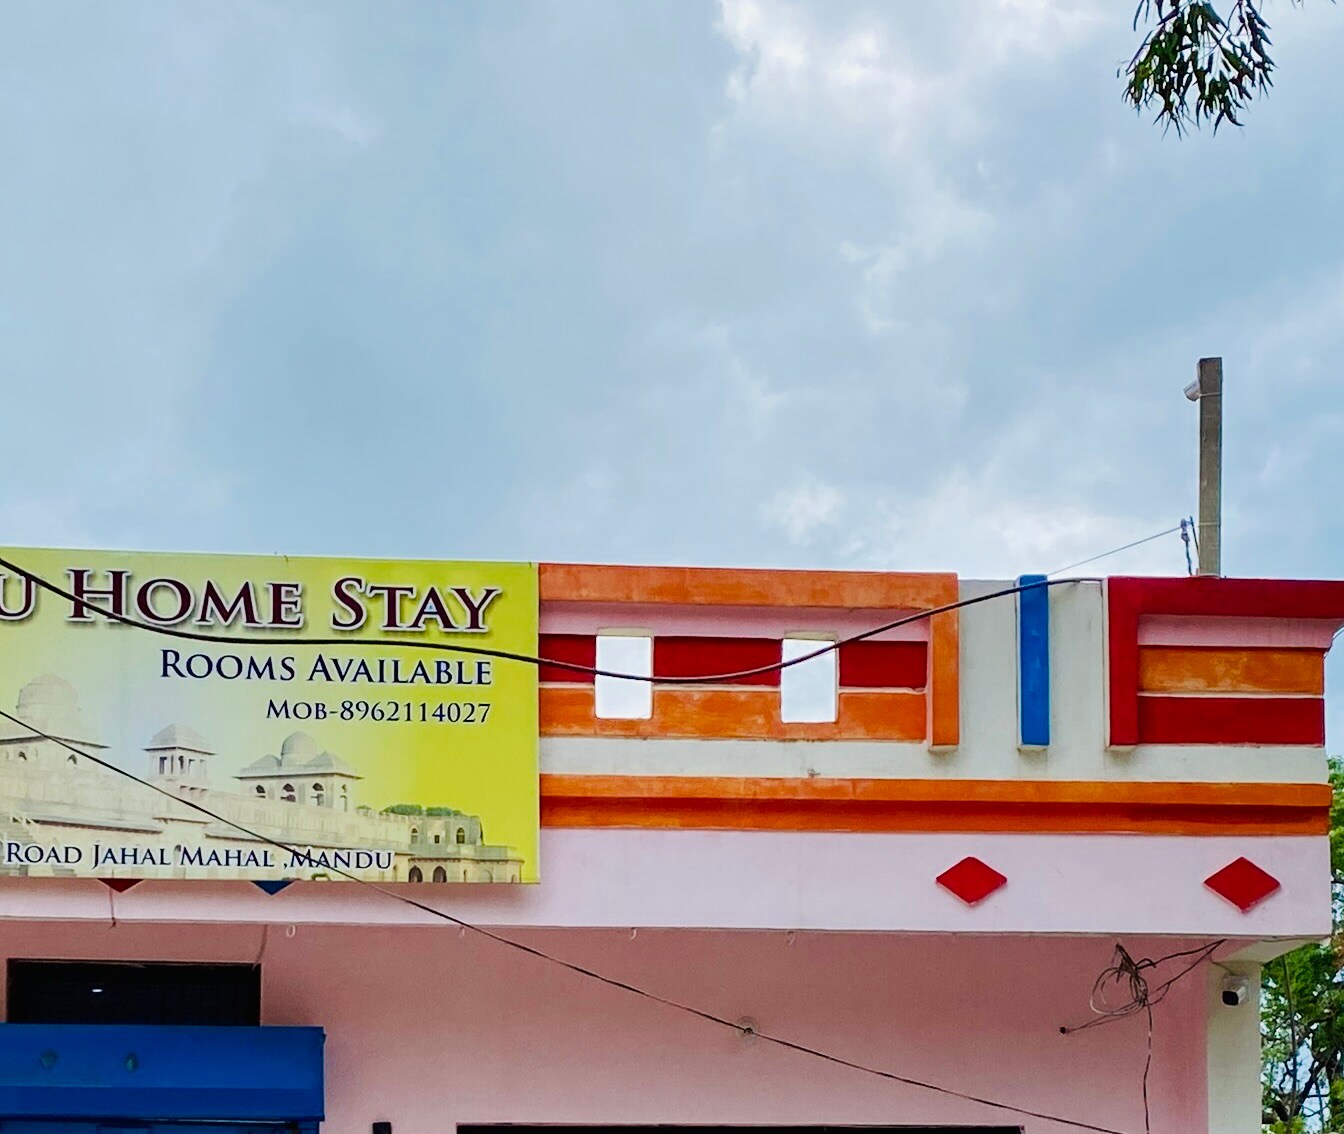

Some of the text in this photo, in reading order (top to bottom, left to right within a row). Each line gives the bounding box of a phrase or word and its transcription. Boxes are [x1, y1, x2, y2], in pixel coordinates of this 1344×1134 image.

[66, 568, 304, 628] HOME
[331, 577, 502, 633] STAY
[160, 649, 493, 686] ROOMS AVAILABLE
[265, 699, 492, 724] MOB-8962114027
[6, 841, 83, 864] ROAD
[91, 844, 172, 870] JAHAL
[180, 846, 276, 868] MAHAL
